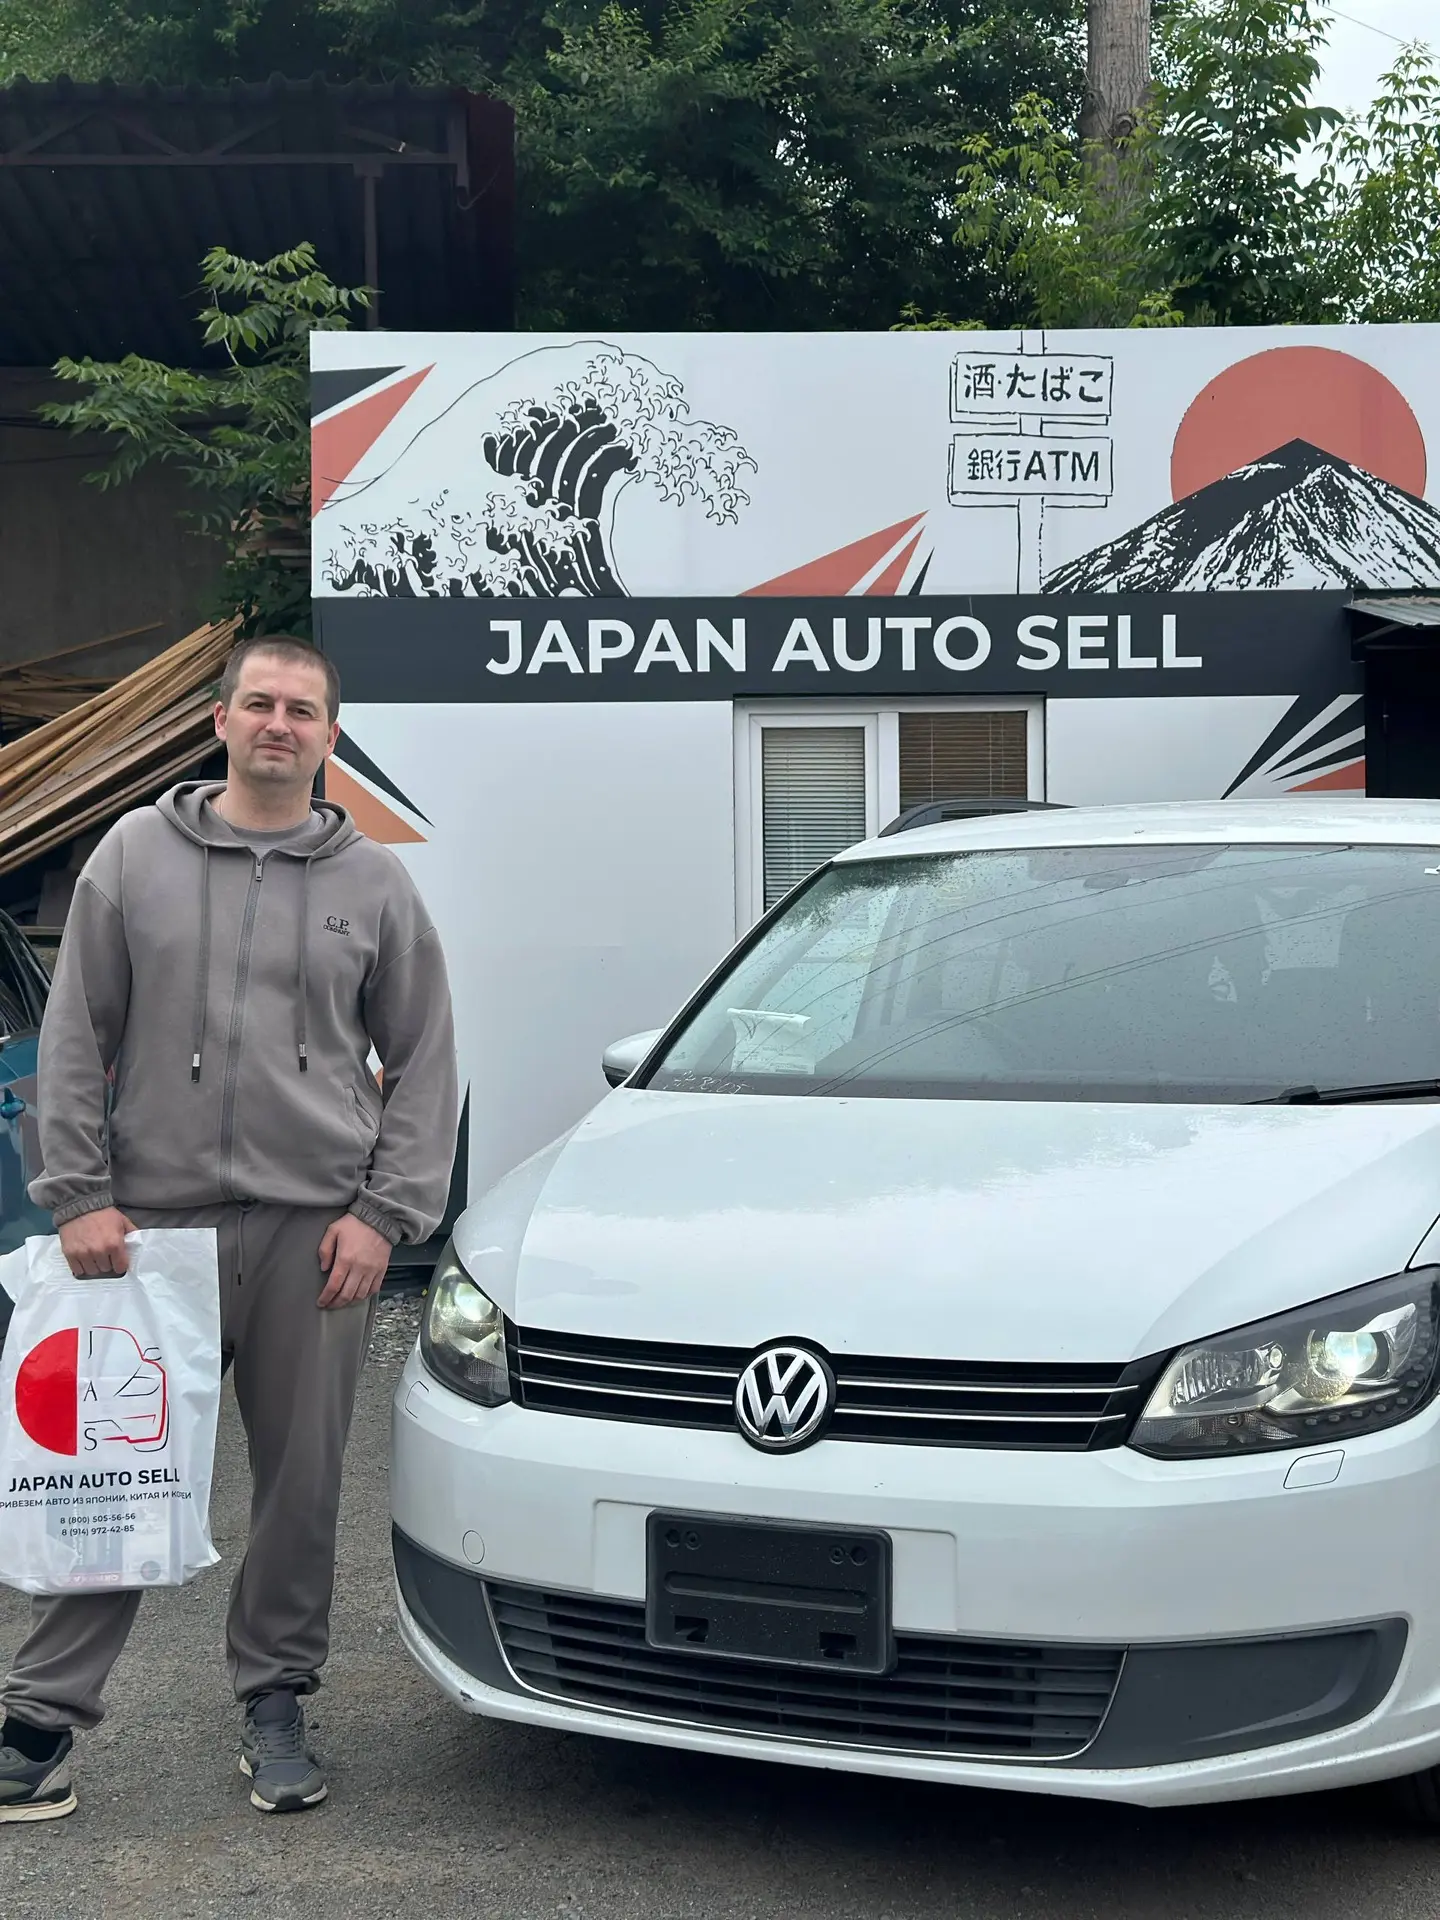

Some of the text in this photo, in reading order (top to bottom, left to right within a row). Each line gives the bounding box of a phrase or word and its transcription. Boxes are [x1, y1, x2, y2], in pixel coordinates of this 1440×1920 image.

[967, 448, 1100, 482] 銀行ATM
[486, 614, 1203, 675] JAPAN AUTO SELL
[9, 1468, 180, 1493] JAPAN AUTO SELL
[0, 1499, 43, 1509] РИВЕЗЕМ
[45, 1497, 71, 1506] АВТО
[72, 1496, 84, 1505] ИЗ
[86, 1494, 128, 1505] ЯПОНИИ,
[130, 1491, 160, 1501] КИТАЯ
[162, 1490, 169, 1499] И
[60, 1512, 136, 1525] 8 (800) 505-56-56
[61, 1524, 135, 1537] 8 (914) 972-42-85
